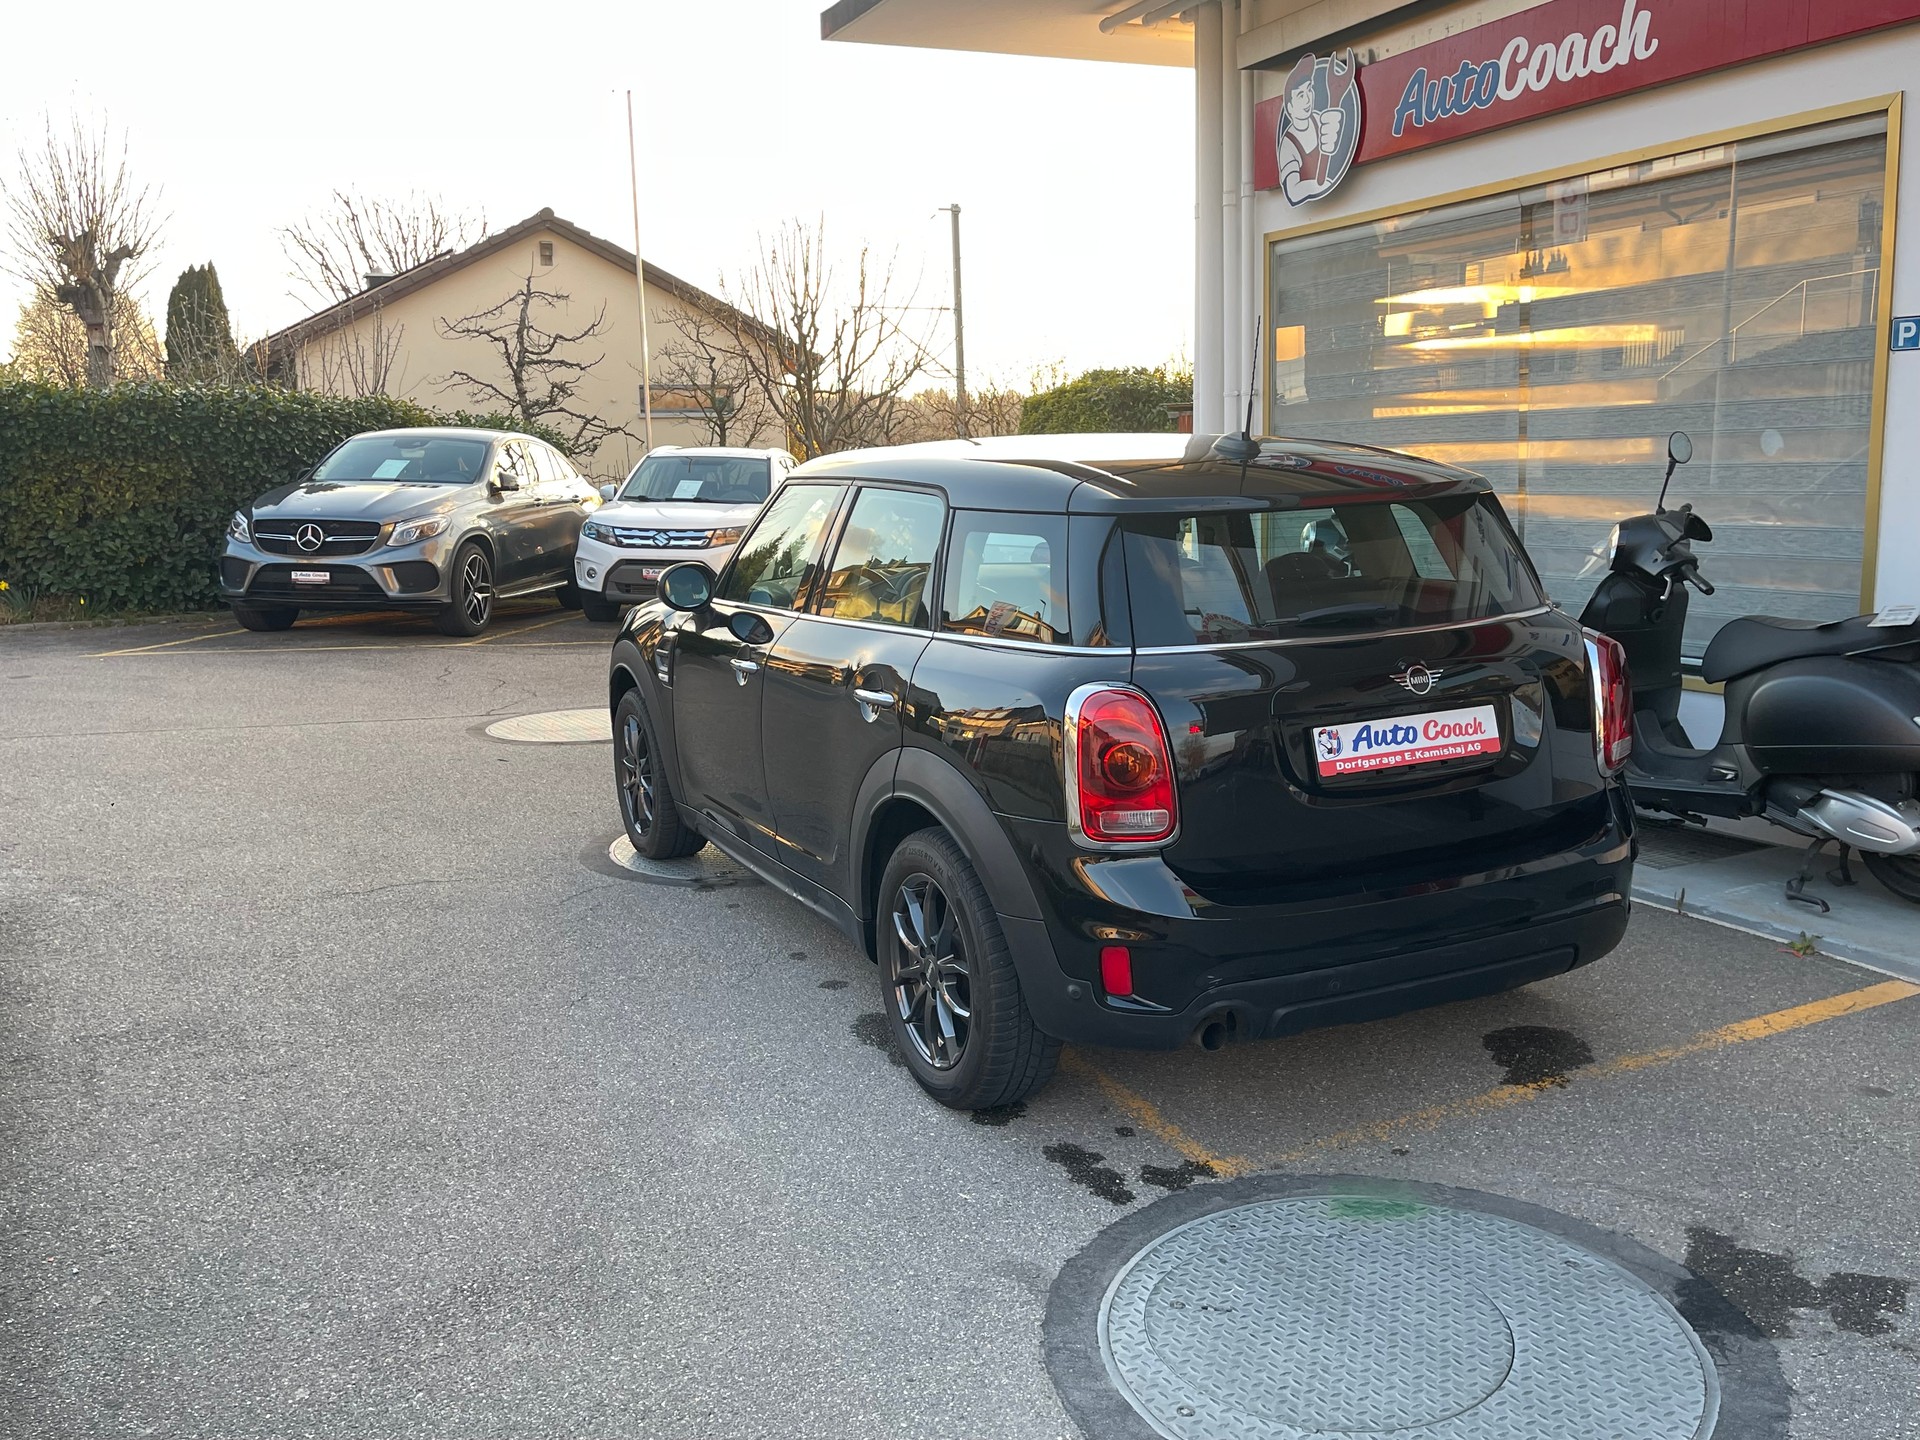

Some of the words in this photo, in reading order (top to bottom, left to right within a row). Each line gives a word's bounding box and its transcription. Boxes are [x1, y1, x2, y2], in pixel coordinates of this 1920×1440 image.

[1898, 322, 1916, 346] P
[1411, 675, 1429, 685] MINI
[1352, 724, 1418, 753] Auto
[1423, 717, 1486, 741] Coach
[1336, 754, 1402, 771] Dorfgarage
[1467, 742, 1481, 752] AG
